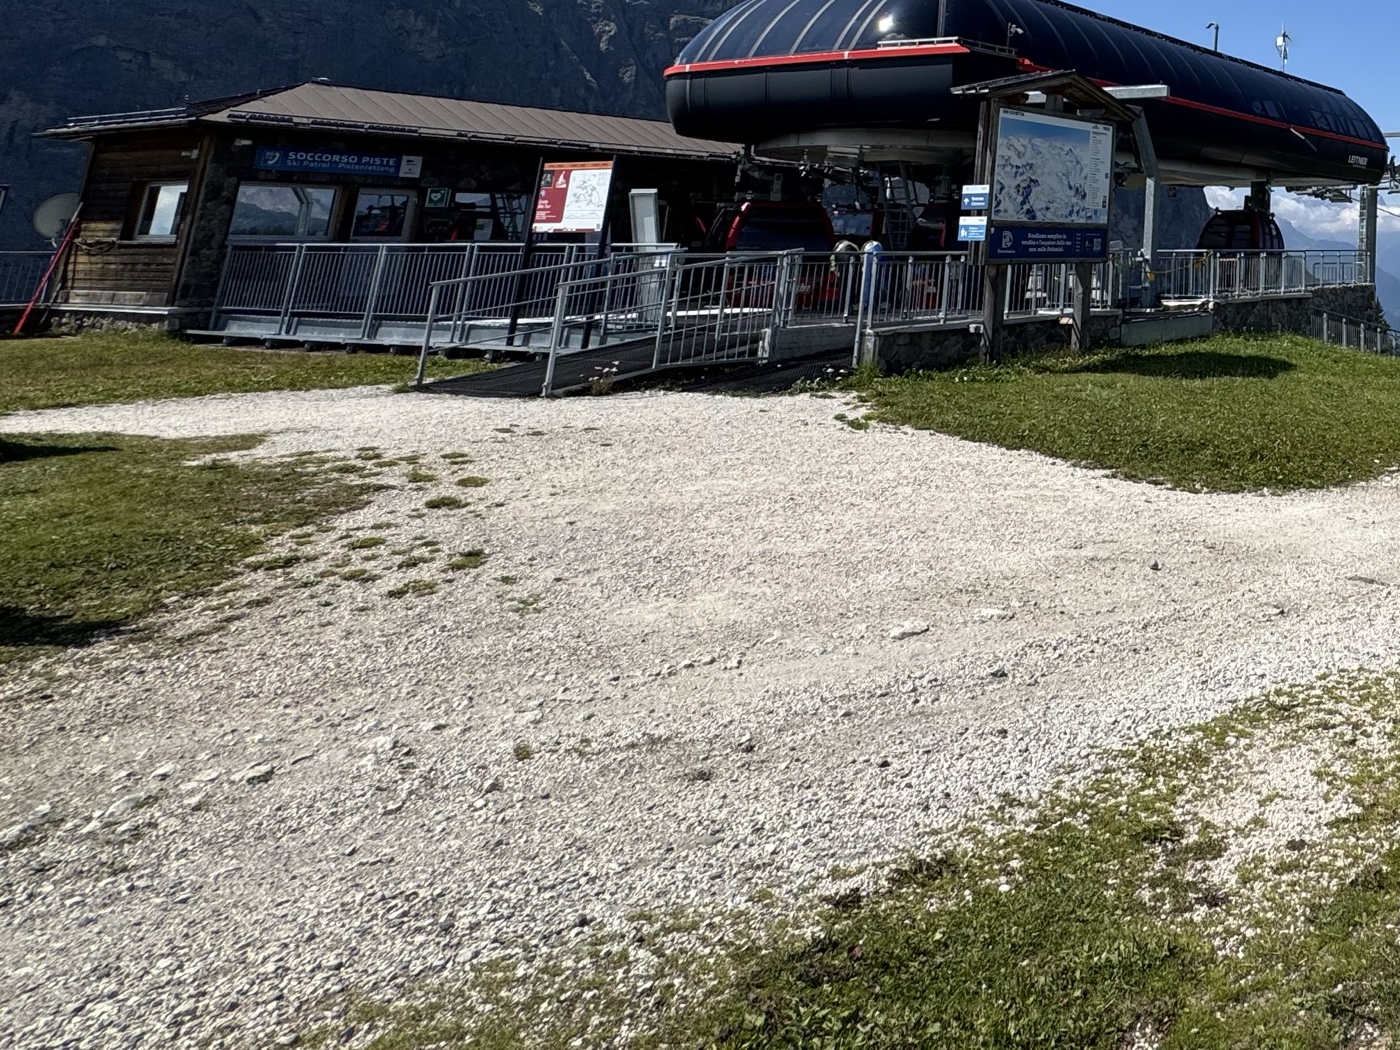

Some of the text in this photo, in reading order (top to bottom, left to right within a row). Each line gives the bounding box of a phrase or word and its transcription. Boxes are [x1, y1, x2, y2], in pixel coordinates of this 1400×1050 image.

[288, 151, 397, 166] SOCCORSO PISTE
[286, 159, 301, 167] Ski
[303, 160, 331, 168] Patrol
[337, 162, 395, 173] Pistenrettung
